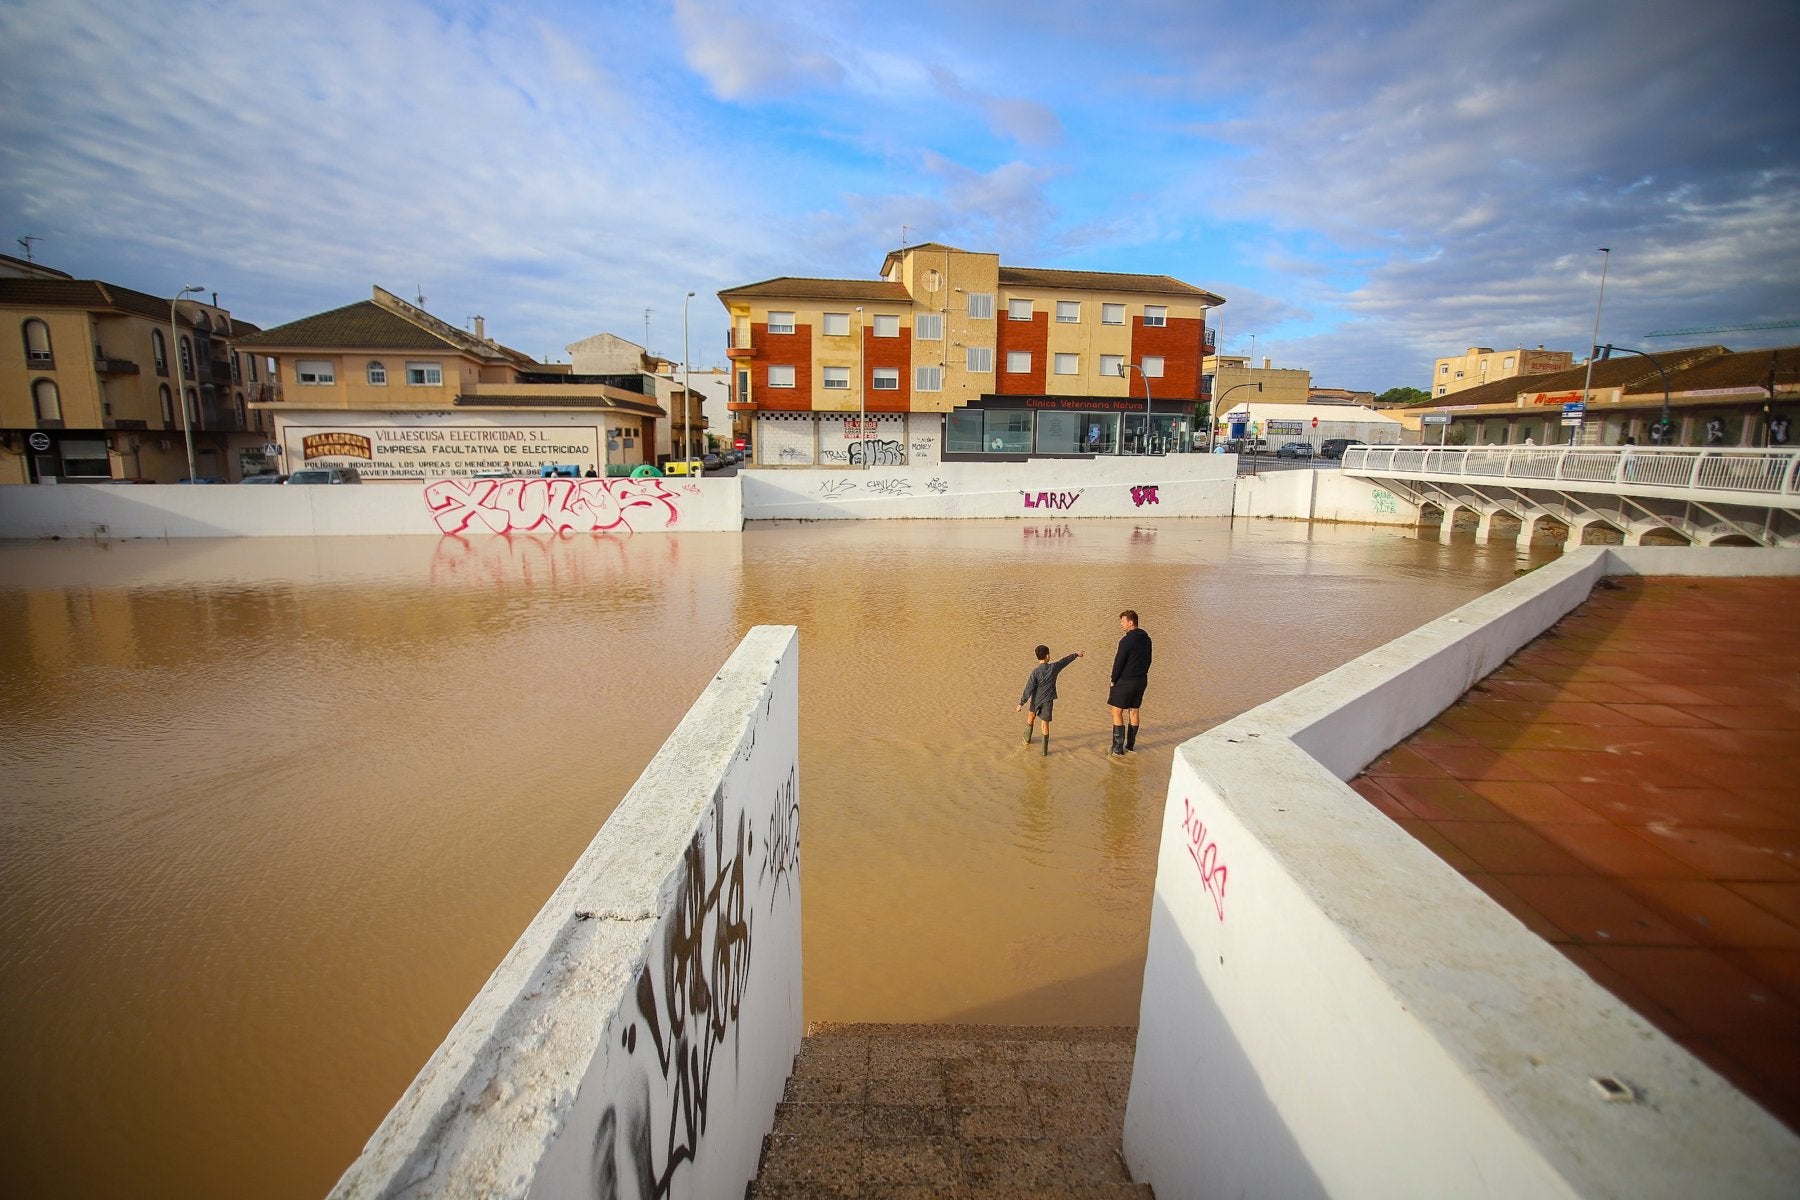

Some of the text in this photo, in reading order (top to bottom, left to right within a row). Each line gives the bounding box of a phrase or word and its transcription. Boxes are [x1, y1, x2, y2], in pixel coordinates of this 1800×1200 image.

[1026, 399, 1144, 410] Clínica Veterinaria Natura
[375, 430, 551, 442] VILLAESCUSA ELECTRICIDAD, S.L.
[376, 445, 589, 454] EMPRESA FACULTATIVA DE ELECTRICIDAD
